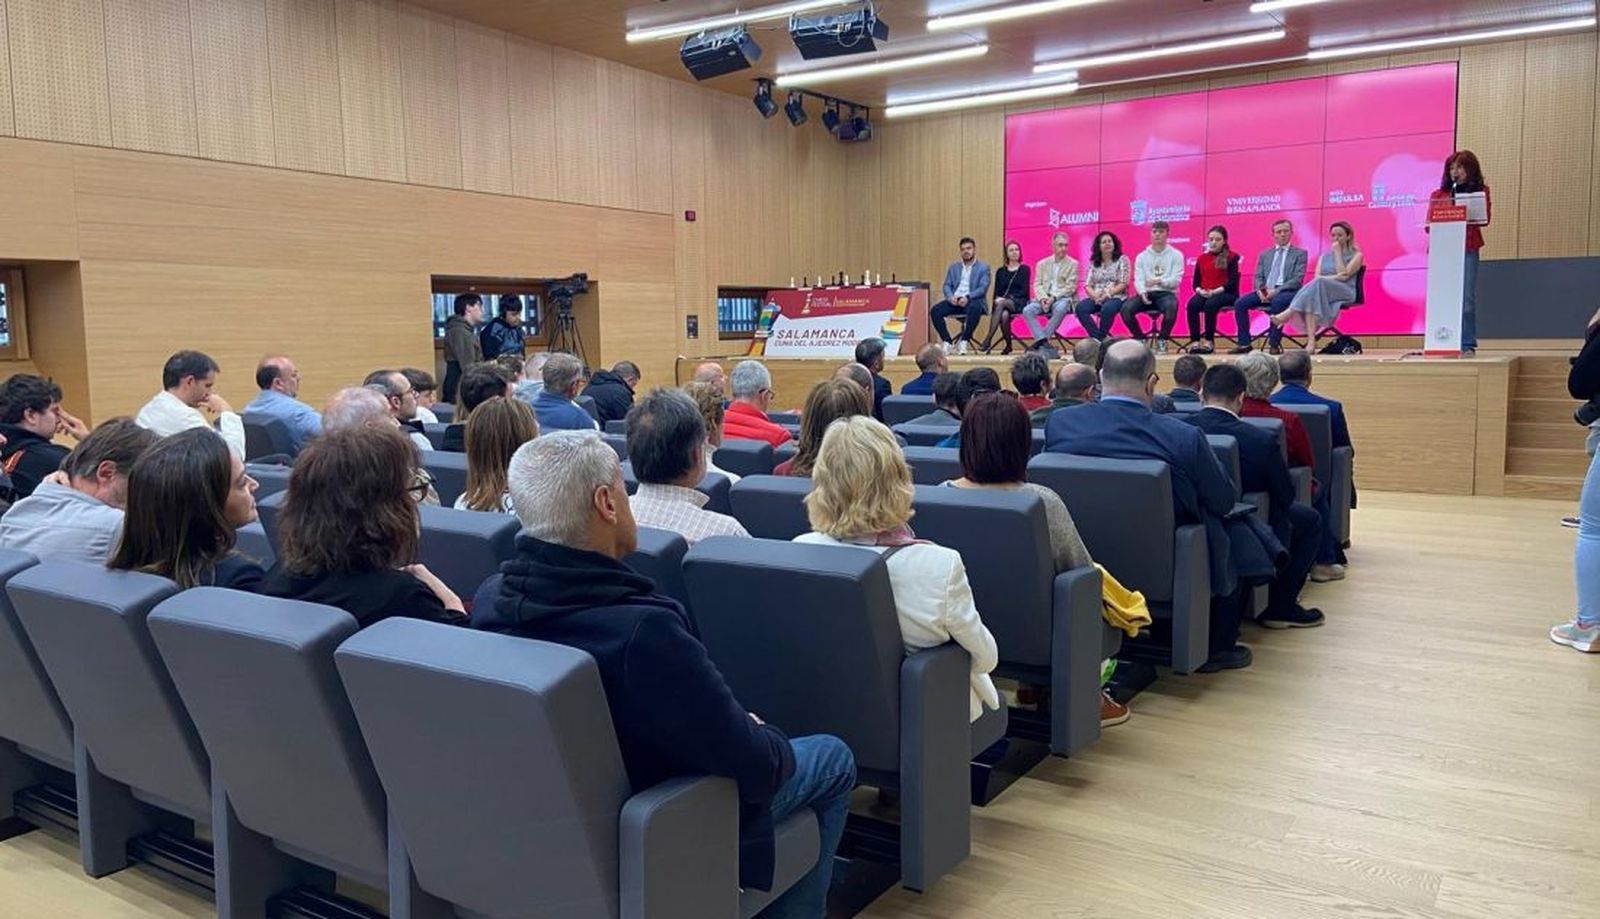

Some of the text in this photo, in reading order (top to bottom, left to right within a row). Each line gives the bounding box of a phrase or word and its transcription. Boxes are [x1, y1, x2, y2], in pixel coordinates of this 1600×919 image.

[1060, 211, 1099, 224] ALUMNI
[777, 328, 856, 339] SALAMANCA
[794, 339, 808, 347] DEL
[808, 339, 841, 347] AJEDREZ
